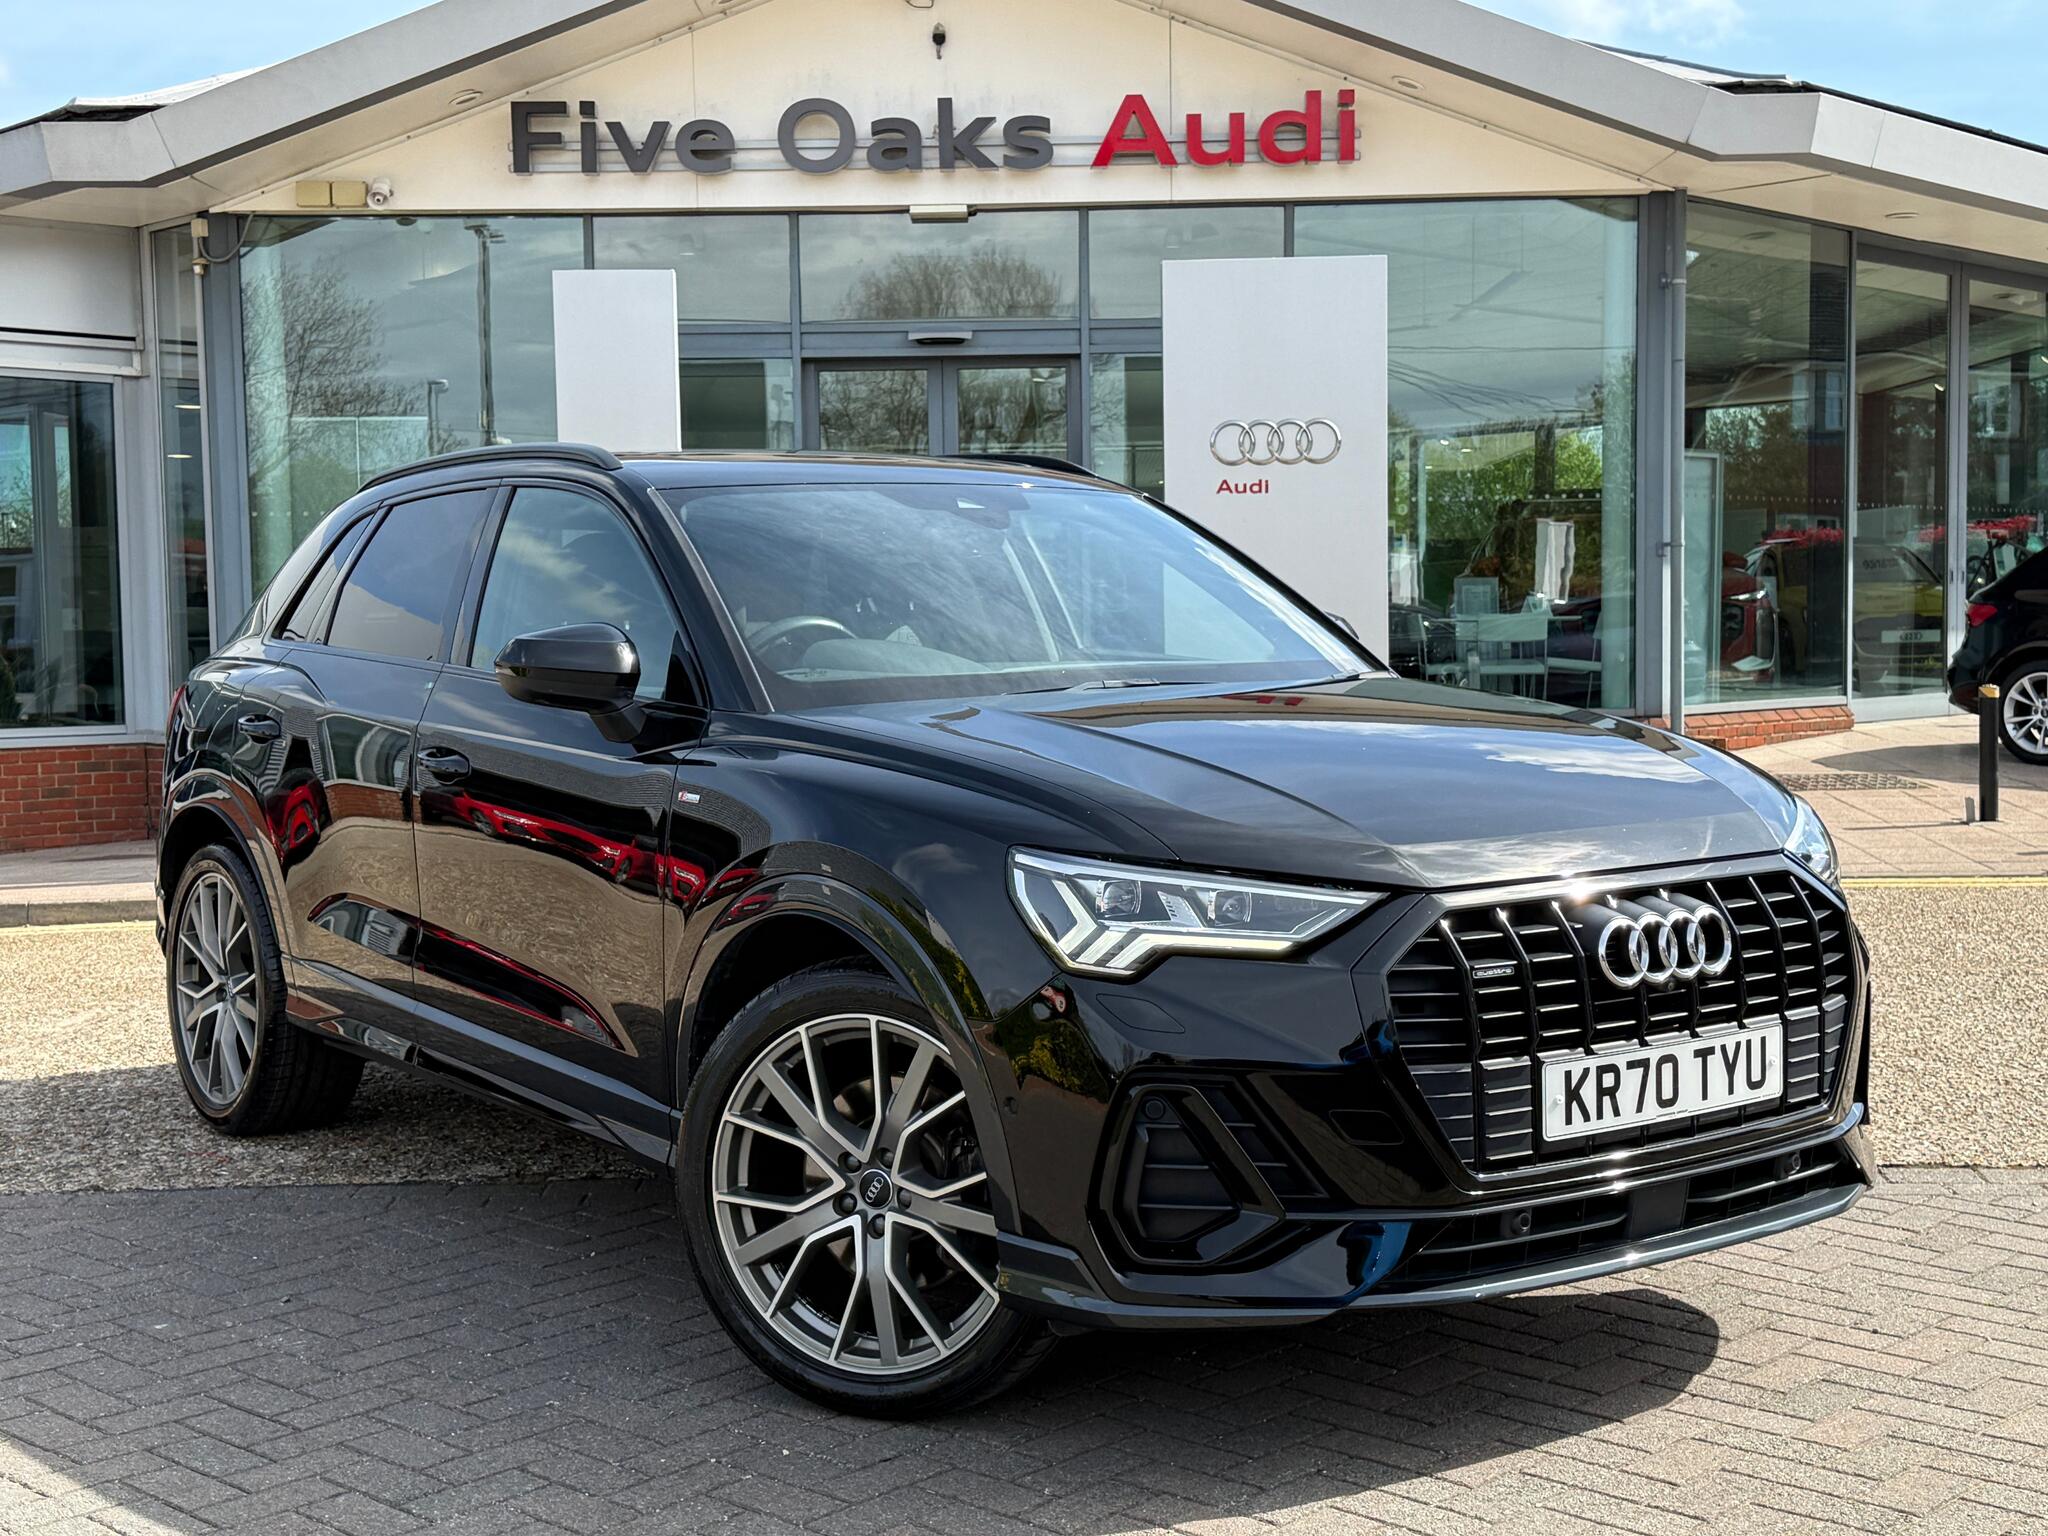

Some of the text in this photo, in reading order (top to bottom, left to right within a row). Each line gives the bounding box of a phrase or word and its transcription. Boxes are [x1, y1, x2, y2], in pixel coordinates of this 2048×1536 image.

[510, 89, 1356, 175] Five Oaks Audi
[1216, 479, 1270, 495] Audi
[1563, 1035, 1767, 1126] KR70 TYU
